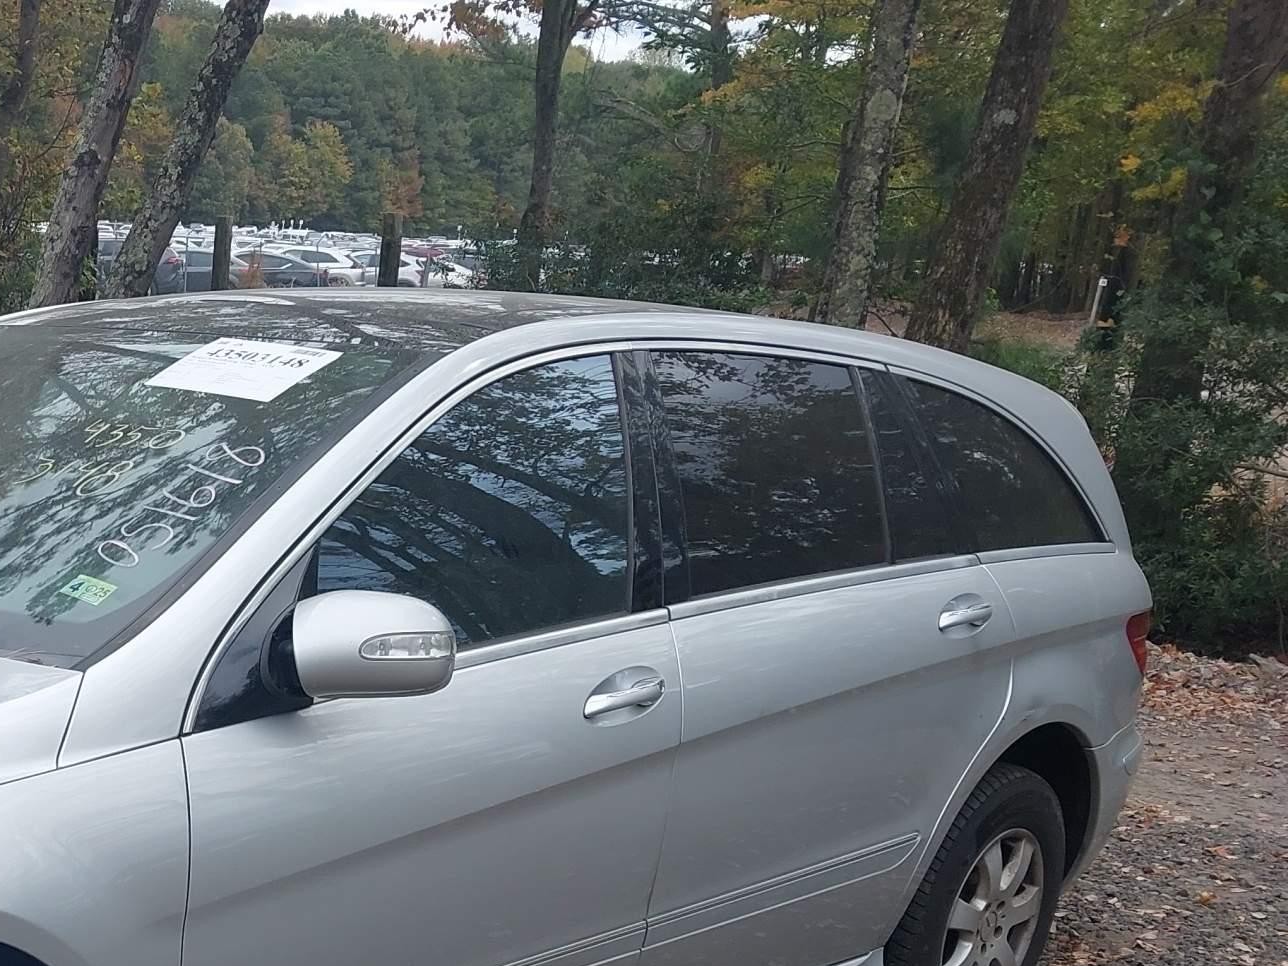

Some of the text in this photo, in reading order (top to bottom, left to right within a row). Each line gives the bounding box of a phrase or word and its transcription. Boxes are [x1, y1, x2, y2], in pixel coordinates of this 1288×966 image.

[208, 348, 309, 369] 43503148
[84, 419, 185, 448] 4350
[13, 455, 134, 496] 3148
[69, 582, 85, 593] 4
